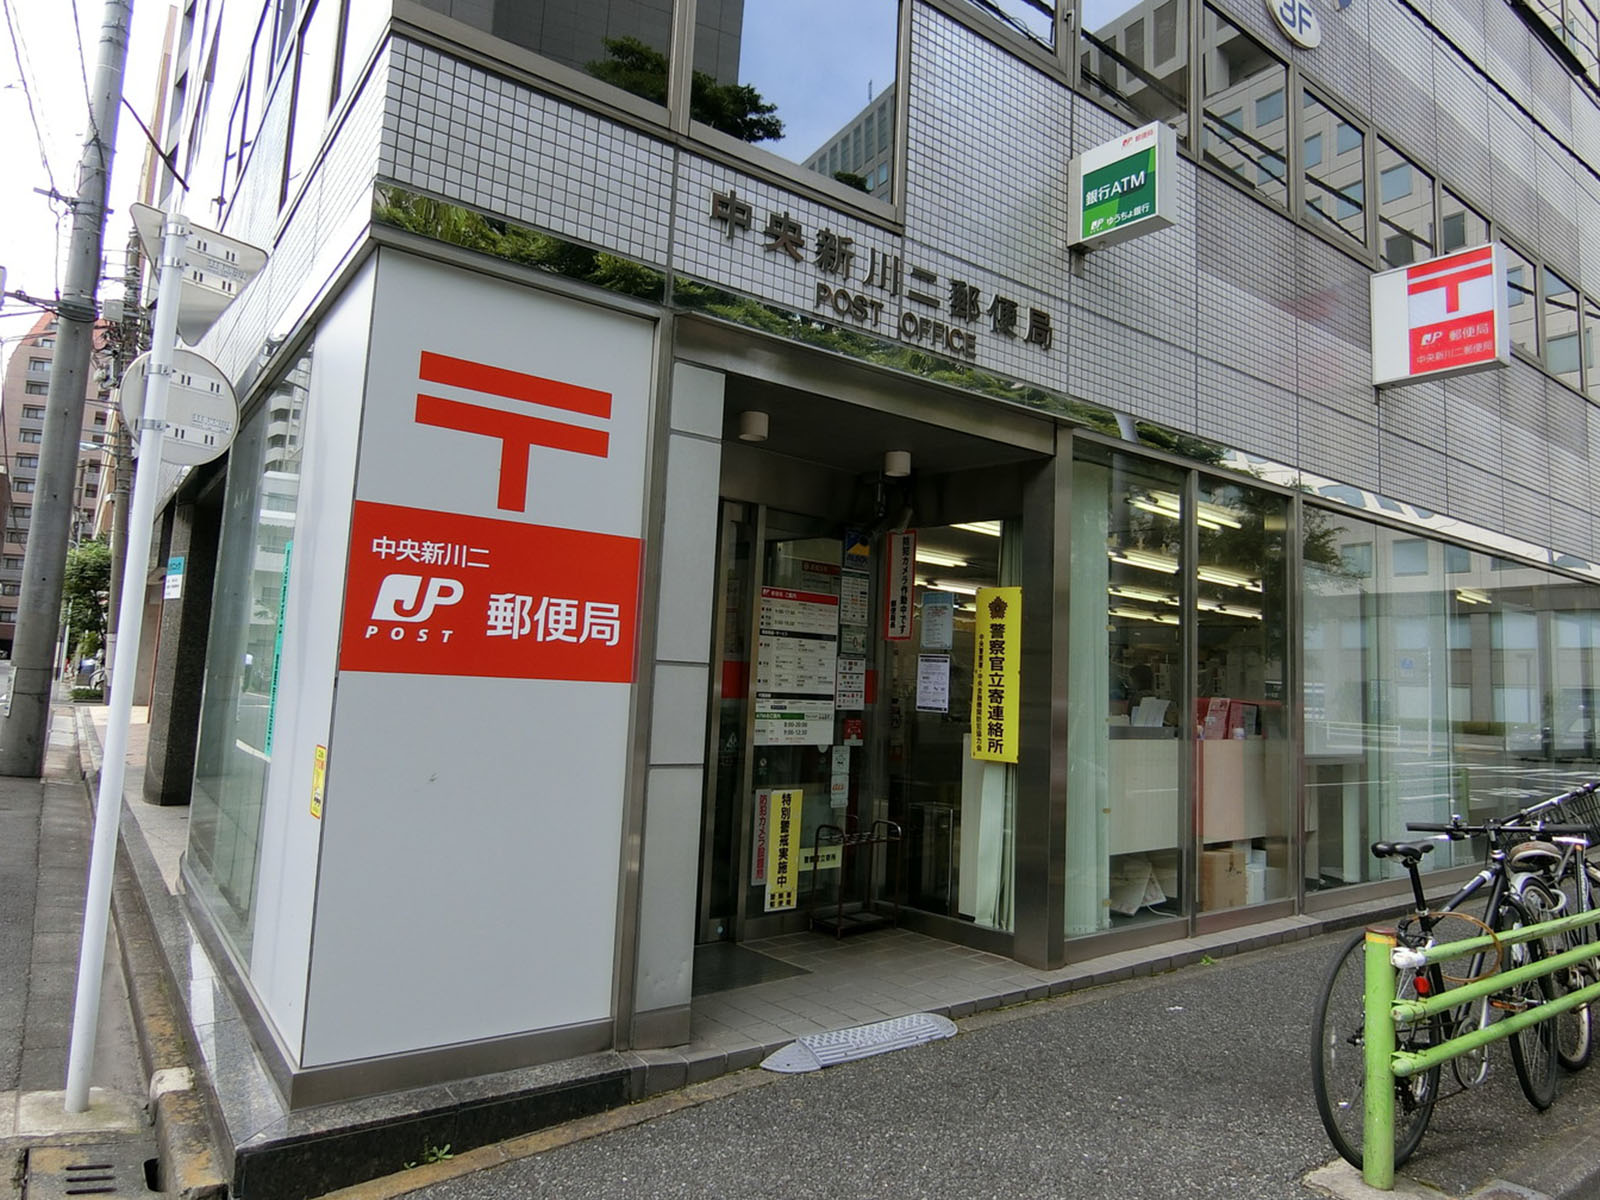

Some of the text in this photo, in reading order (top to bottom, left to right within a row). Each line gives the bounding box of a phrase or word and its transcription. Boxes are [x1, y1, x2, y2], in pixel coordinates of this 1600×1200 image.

[1085, 170, 1145, 207] 銀行ATM
[1106, 202, 1150, 226] ゆうちょ銀行
[709, 189, 1053, 350] 中央新川二郵便局
[814, 281, 977, 359] POST OFFICE
[1449, 322, 1489, 342] 郵便局
[1416, 340, 1493, 363] 中央新川二郵便局
[372, 536, 490, 568] 中央新川二
[365, 625, 453, 643] POST
[486, 592, 620, 646] 郵便局
[988, 623, 1006, 754] 警察官立寄連絡所
[777, 793, 792, 888] 特別警戒実施中
